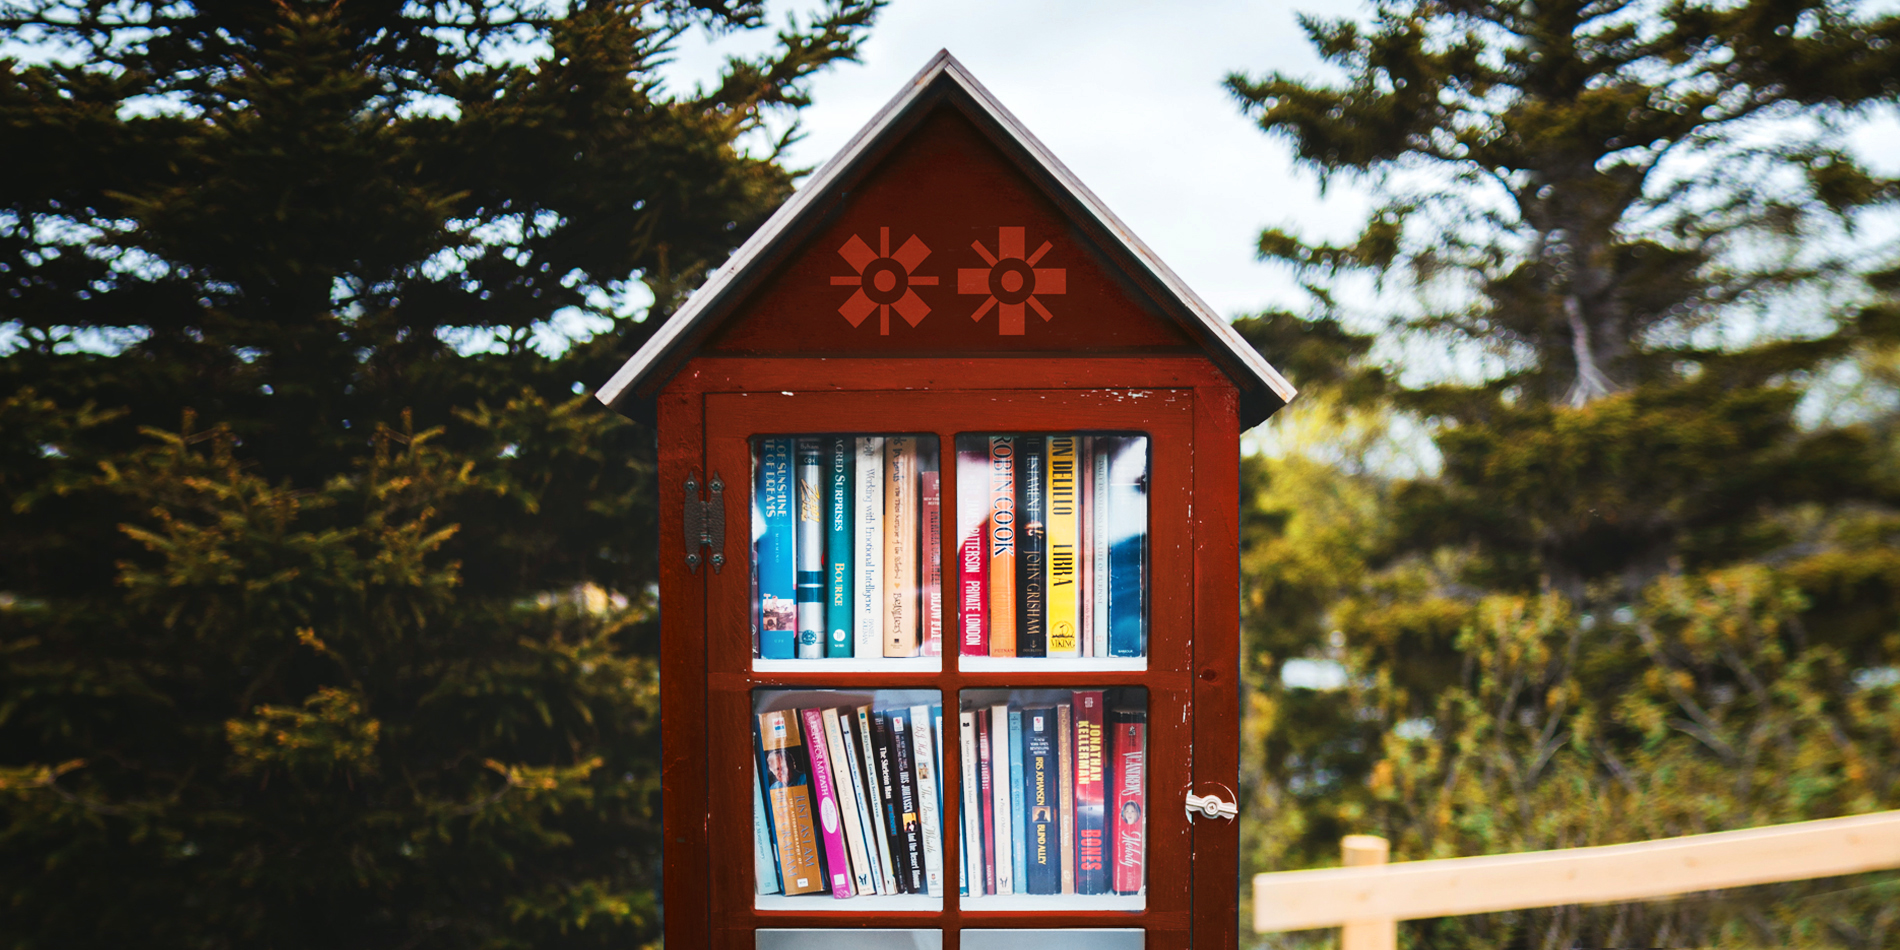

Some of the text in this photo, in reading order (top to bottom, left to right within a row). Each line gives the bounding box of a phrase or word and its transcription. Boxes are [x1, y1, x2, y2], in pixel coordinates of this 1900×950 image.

[765, 438, 776, 518] TE OF DREAMS
[834, 438, 846, 532] ACRED SURPRISES
[863, 468, 875, 502] Working
[992, 437, 1014, 558] ROBIN COOK
[1026, 452, 1041, 512] TESTAMENT
[1052, 438, 1073, 515] ON DELILLO
[866, 505, 876, 524] with
[866, 526, 876, 567] Emotional
[965, 528, 980, 572] PATTERSON
[1052, 544, 1073, 586] LIBRA
[1098, 563, 1103, 572] OF
[834, 563, 844, 606] BOURKE
[862, 570, 875, 614] Intelligence
[1023, 550, 1040, 634] JOHN GRISHAM
[966, 581, 980, 646] PRIVATE LONDON
[1050, 639, 1076, 648] VIKING
[813, 744, 822, 760] FOR
[816, 761, 825, 774] MY
[881, 759, 890, 785] Skeleton
[1078, 720, 1090, 784] KELLERMAN
[1090, 724, 1102, 781] JONATHAN
[820, 775, 828, 796] PATH
[900, 771, 913, 813] IRIS JOHANSEN
[1036, 756, 1045, 806] IRIS JOHANSEN
[795, 795, 808, 820] JUST
[920, 785, 938, 854] The Penny Whistle
[775, 790, 798, 877] BILLY GRAHAM
[791, 810, 800, 856] AUTOBIOGRAPHY
[800, 824, 811, 838] AS
[1037, 824, 1046, 865] BLIND ALLEY
[1080, 830, 1102, 870] BONES
[1120, 830, 1141, 867] Melody
[803, 846, 814, 867] AM
[908, 832, 920, 889] And the Desert Blooms
